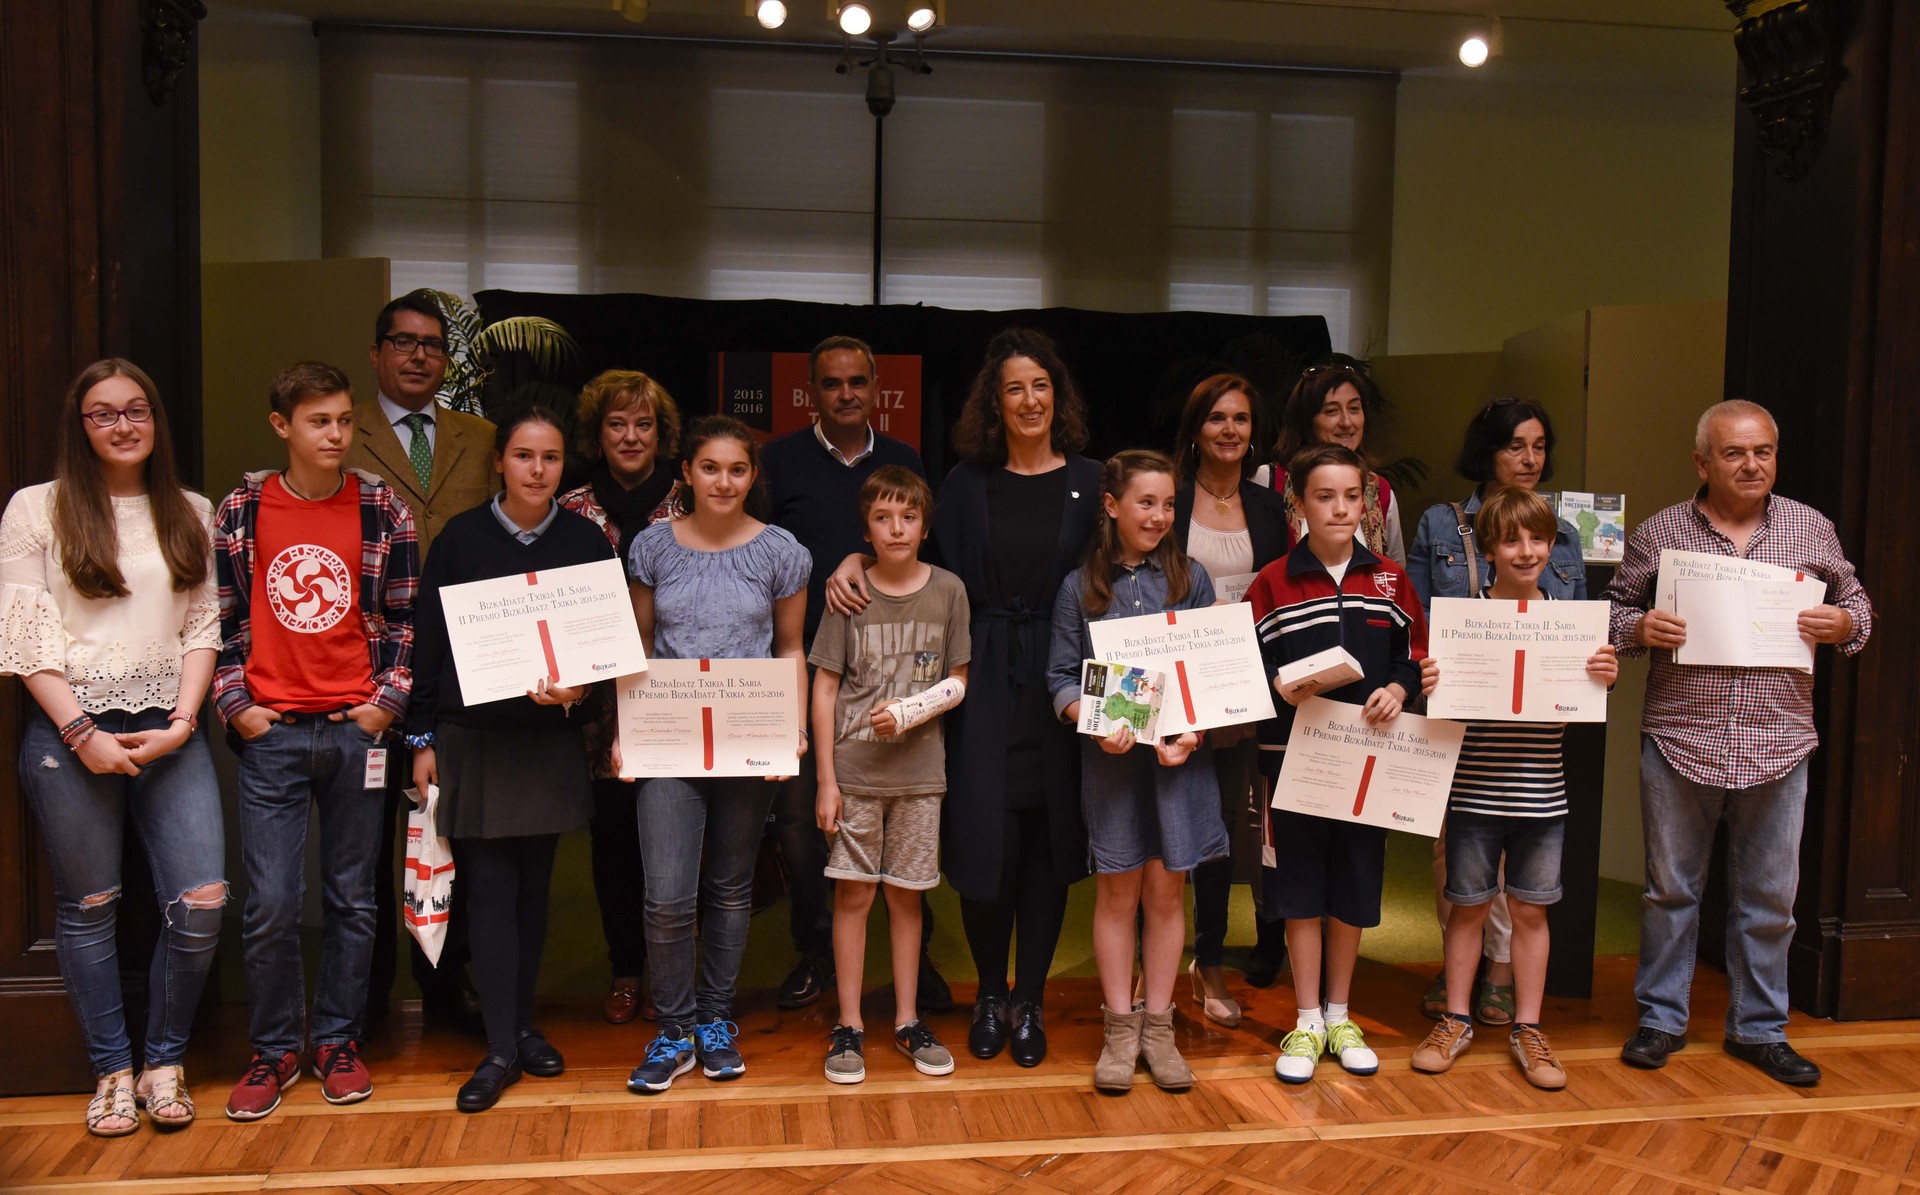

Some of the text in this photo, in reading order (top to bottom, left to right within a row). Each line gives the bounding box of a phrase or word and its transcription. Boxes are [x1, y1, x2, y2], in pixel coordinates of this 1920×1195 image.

[734, 390, 763, 400] 2015
[734, 404, 763, 413] 2016
[288, 547, 342, 577] EUSKERA
[1688, 569, 1714, 578] PREMIO
[336, 574, 349, 607] GORA
[528, 592, 554, 602] TXIKIA
[570, 585, 592, 595] SARIA
[459, 616, 466, 625] II
[469, 612, 500, 623] PREMIO
[552, 599, 578, 610] TXIKIA
[1514, 620, 1539, 629] TXIKIA
[1554, 621, 1575, 630] SARIA
[1167, 632, 1191, 641] TXIKIA
[1204, 627, 1224, 637] SARIA
[1441, 630, 1448, 638] II
[1451, 630, 1482, 639] PREMIO
[1534, 633, 1559, 641] TXIKIA
[1106, 652, 1112, 661] II
[1115, 650, 1143, 660] PREMIO
[1188, 640, 1212, 650] TXIKIA
[596, 662, 616, 671] Bizkaia
[739, 679, 761, 687] SARIA
[629, 690, 635, 699] II
[639, 690, 668, 699] PREMIO
[719, 690, 745, 698] TXIKIA
[1304, 726, 1310, 736] II
[1313, 728, 1341, 742] PREMIO
[1387, 741, 1410, 753] TXIKIA
[1372, 728, 1395, 740] TXIKIA
[1408, 733, 1428, 745] SARIA
[1395, 813, 1414, 823] Bizkaia
